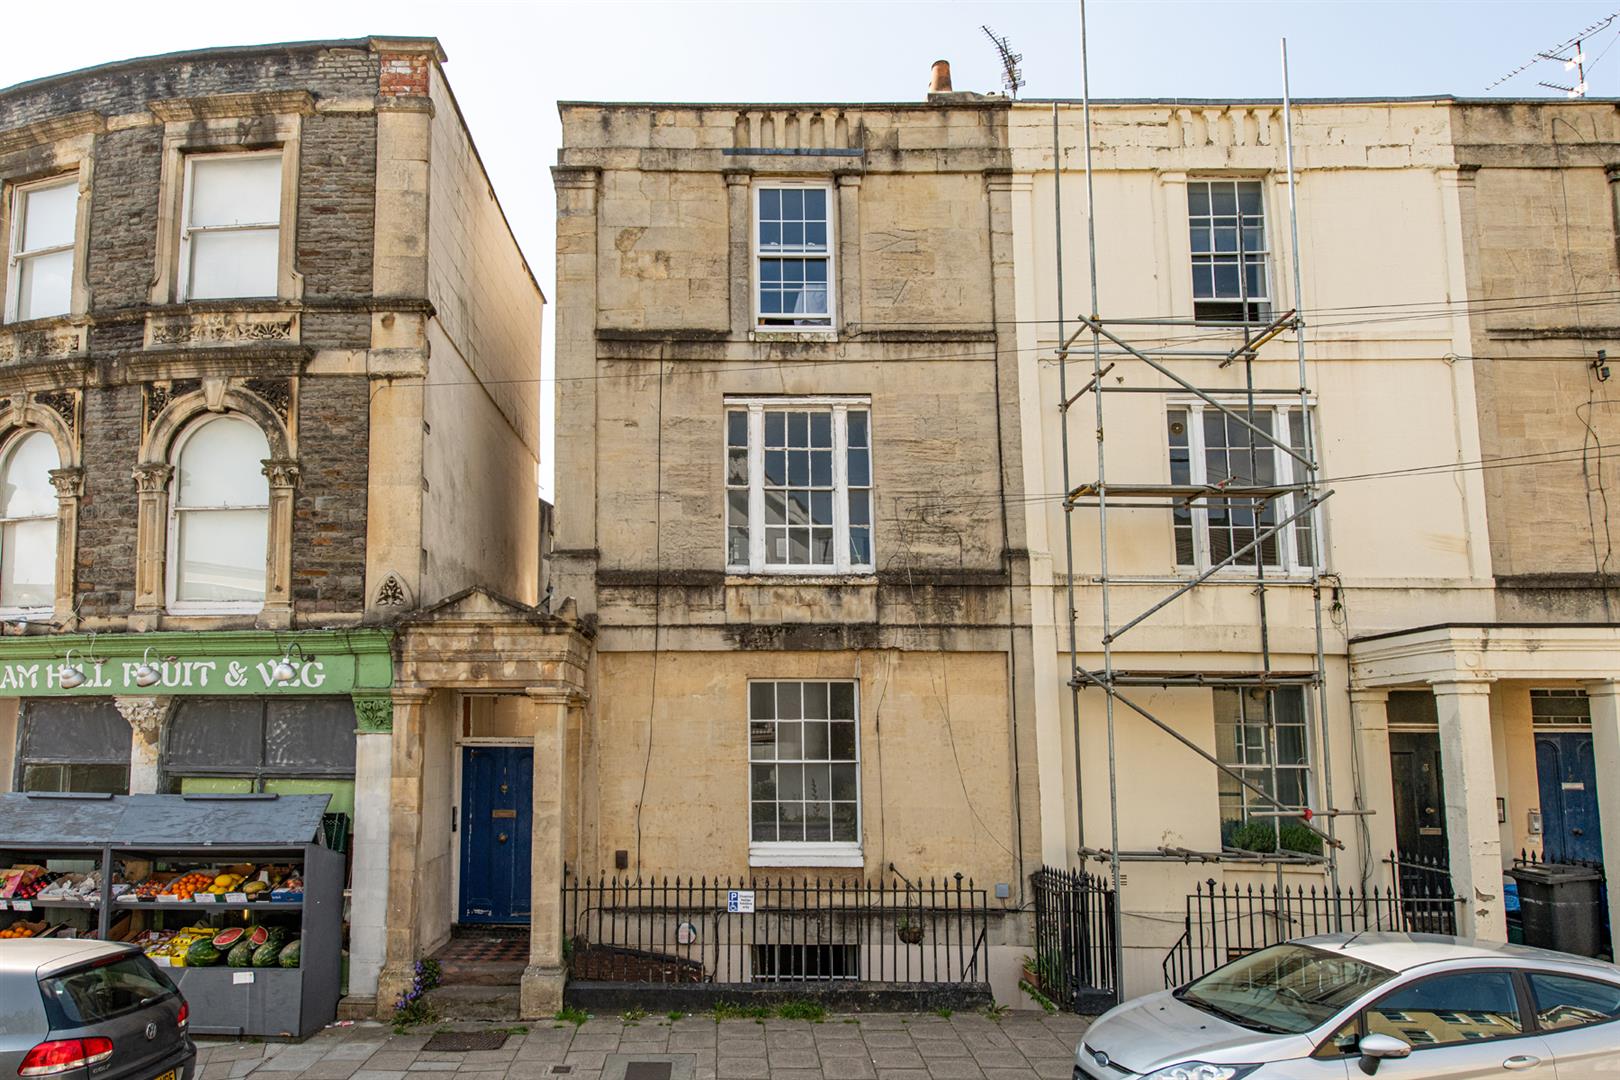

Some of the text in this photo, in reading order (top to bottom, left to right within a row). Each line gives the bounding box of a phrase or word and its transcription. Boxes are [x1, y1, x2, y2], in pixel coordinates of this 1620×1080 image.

[0, 664, 40, 689] AM
[46, 663, 112, 689] HLL
[224, 661, 248, 687] &
